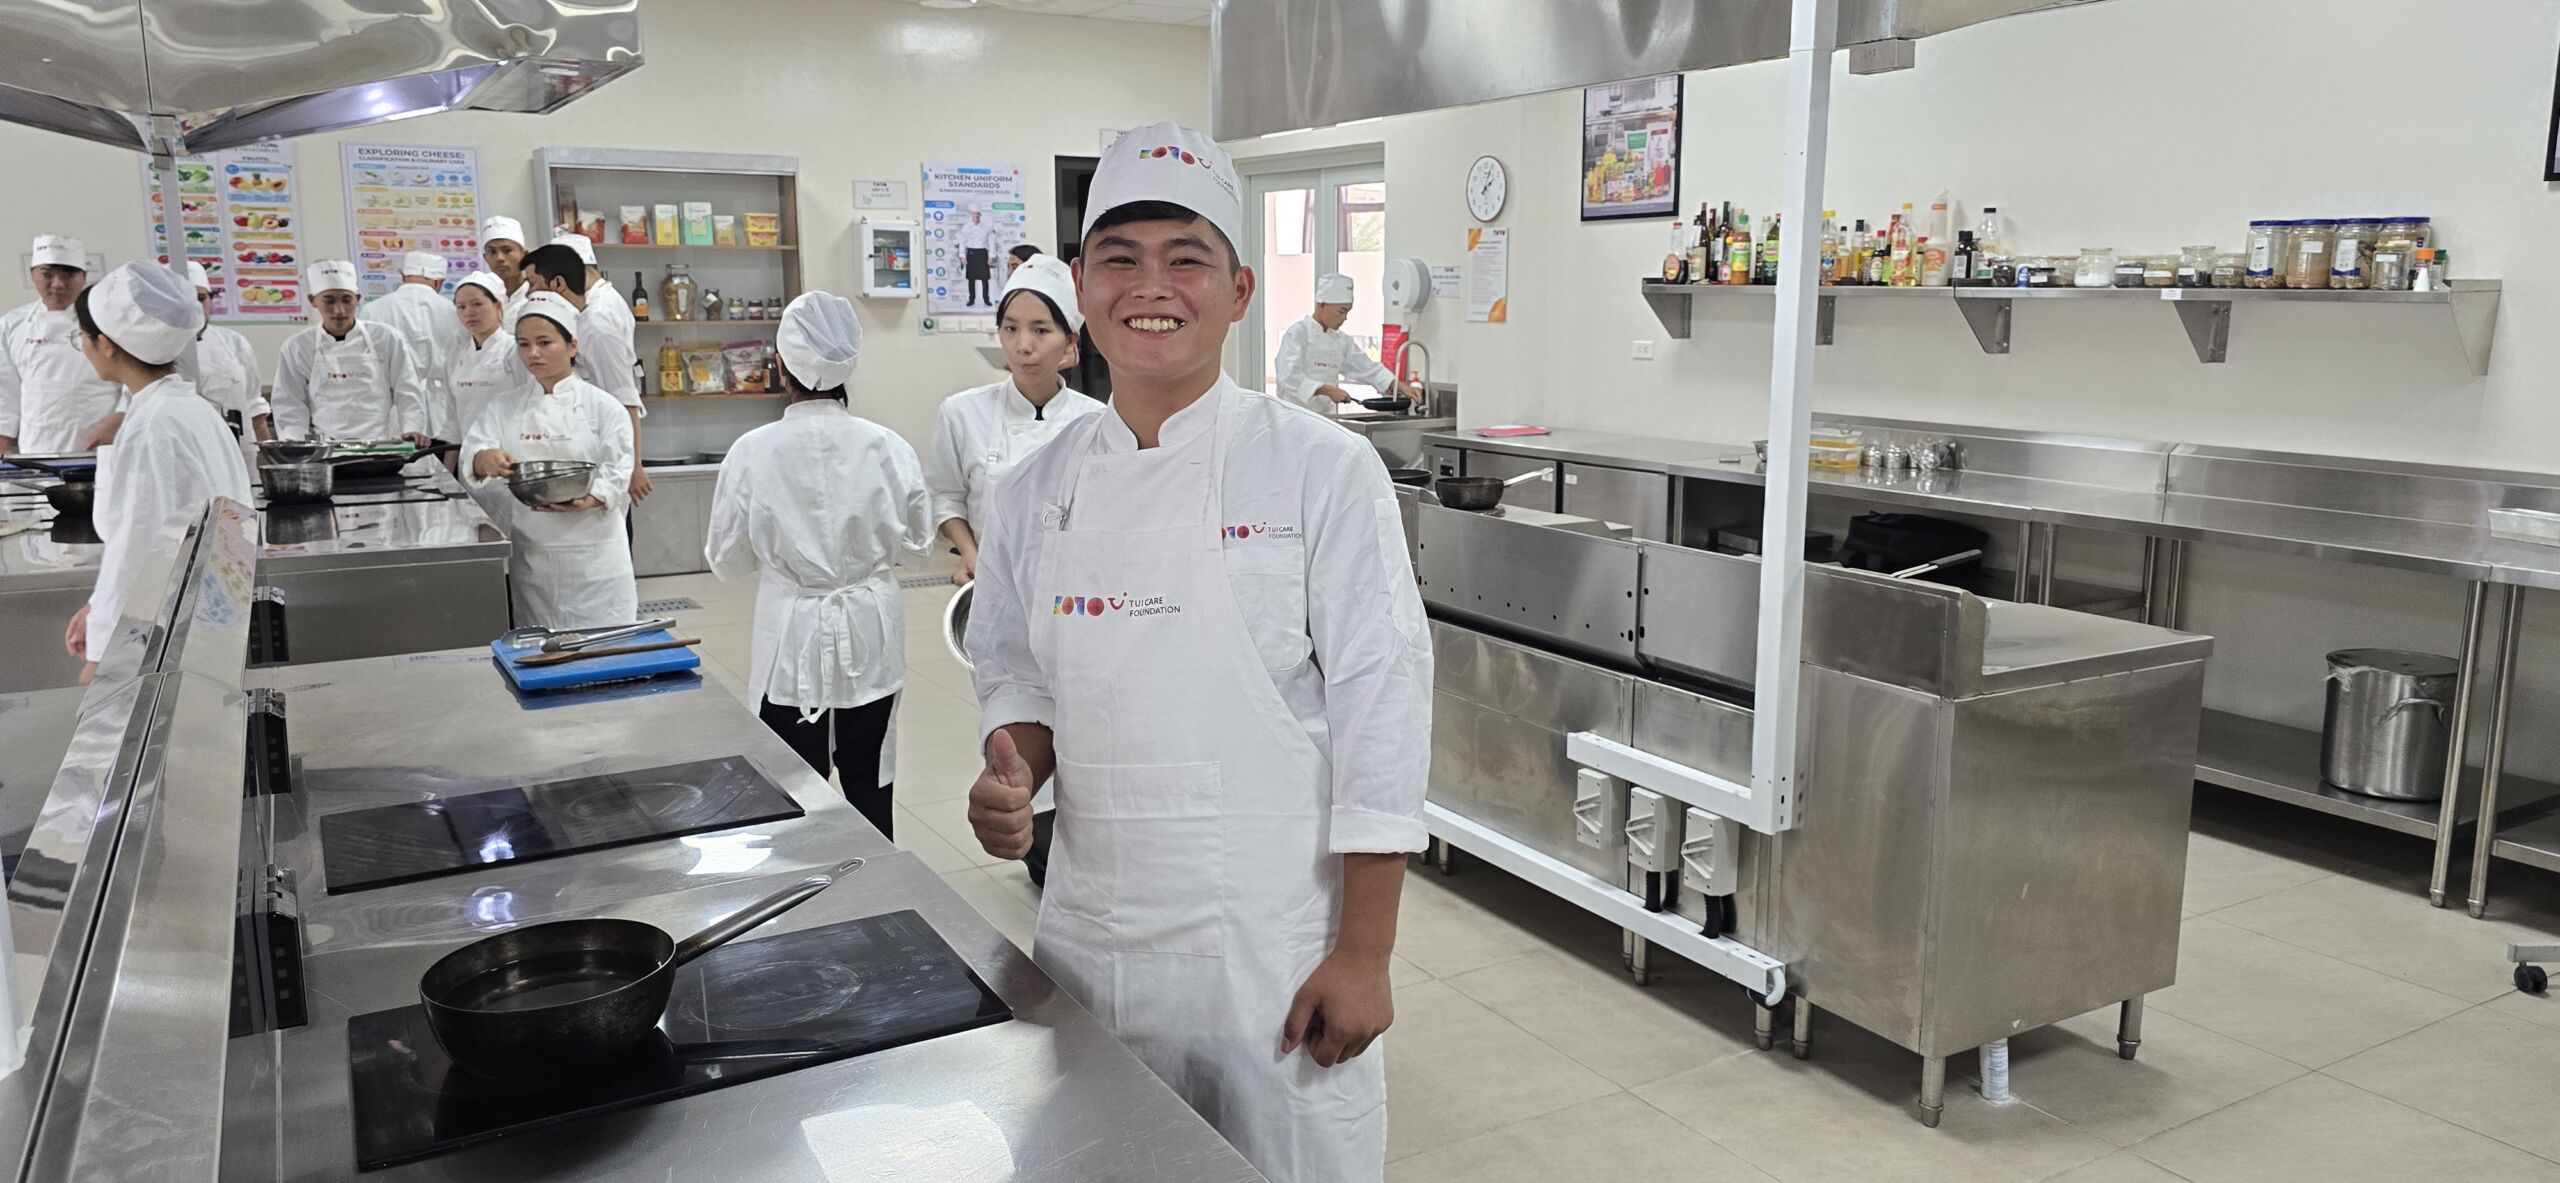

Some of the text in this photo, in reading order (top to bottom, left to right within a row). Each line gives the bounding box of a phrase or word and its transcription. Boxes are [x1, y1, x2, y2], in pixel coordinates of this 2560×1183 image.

[358, 148, 465, 159] EXPLORING CHEESE:
[934, 173, 971, 181] KITCHEN
[948, 181, 1001, 189] STANDARDS
[1144, 597, 1164, 606] CARE
[1129, 606, 1181, 617] FOUNDATION
